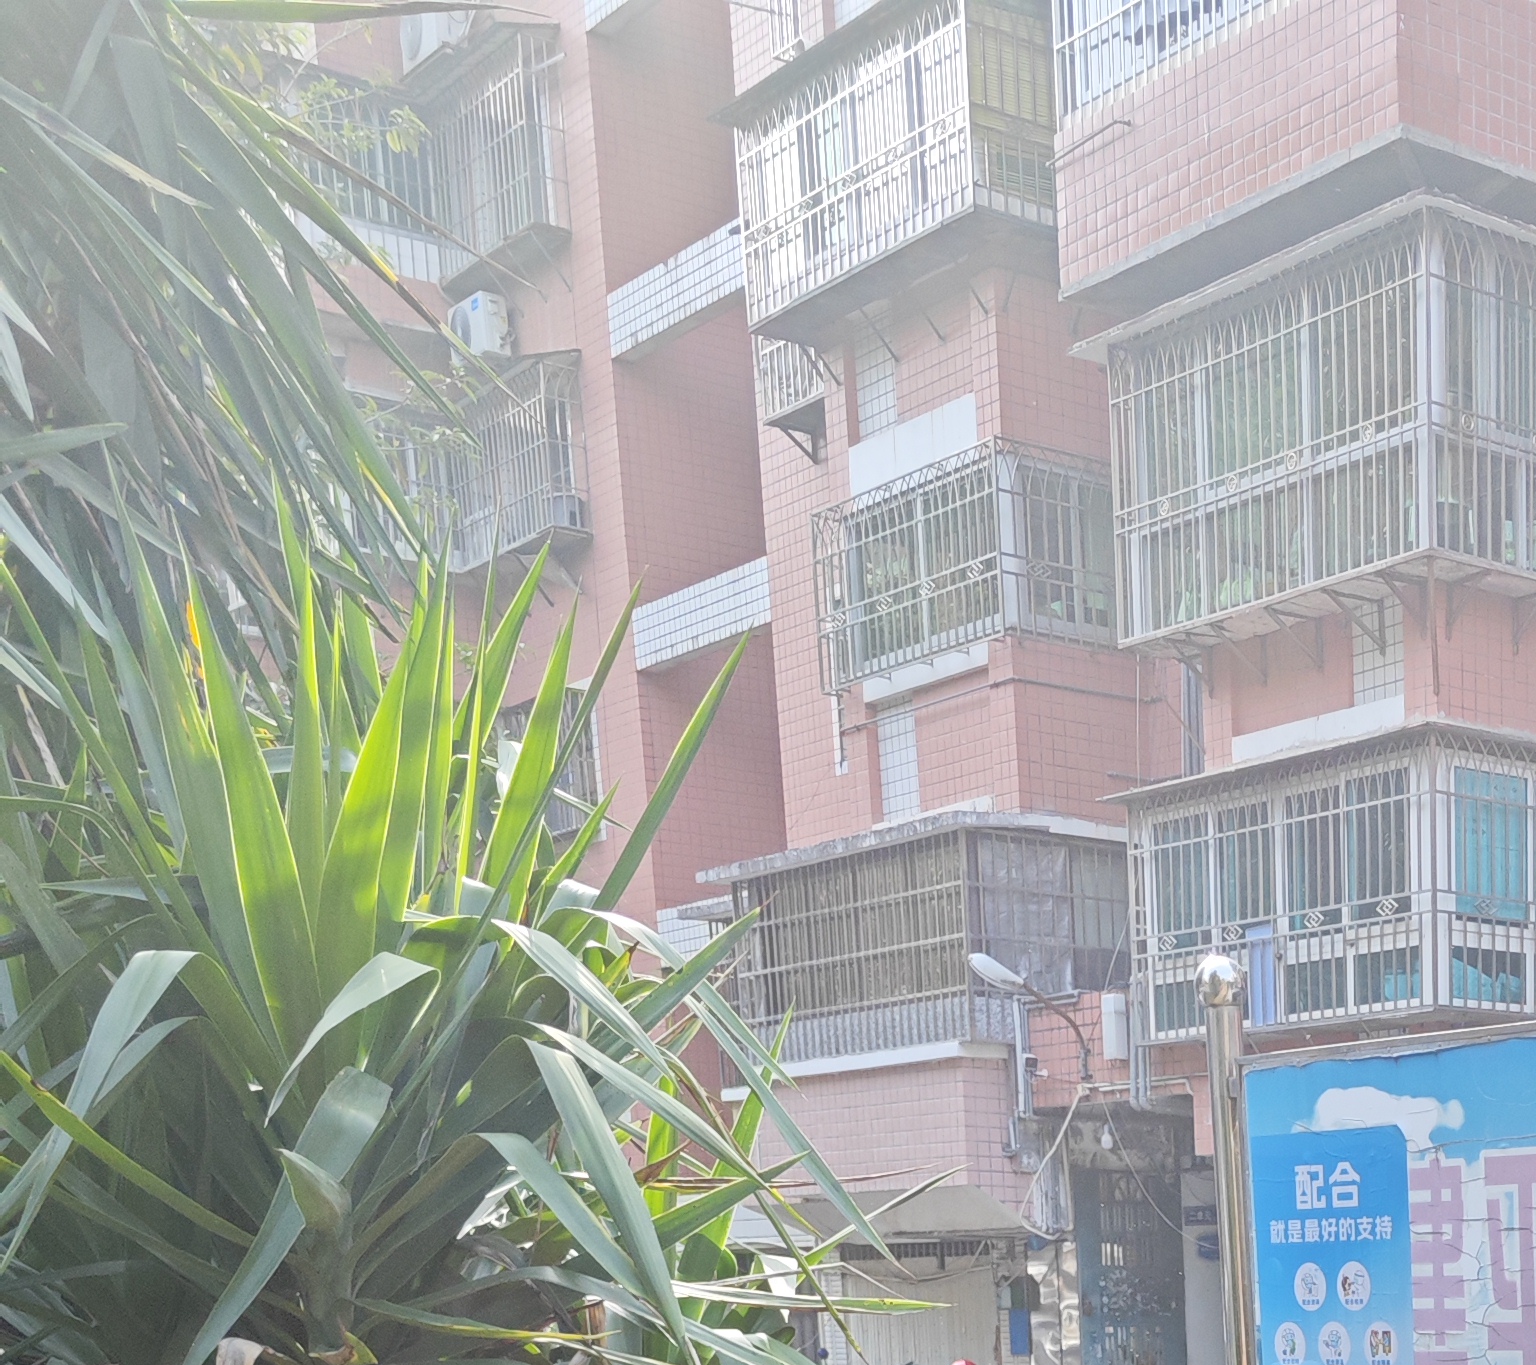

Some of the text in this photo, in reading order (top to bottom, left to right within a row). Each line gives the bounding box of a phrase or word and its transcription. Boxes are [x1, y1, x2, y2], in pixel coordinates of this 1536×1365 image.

[1294, 1161, 1361, 1210] 配合
[1269, 1214, 1393, 1244] 就是最好的支持
